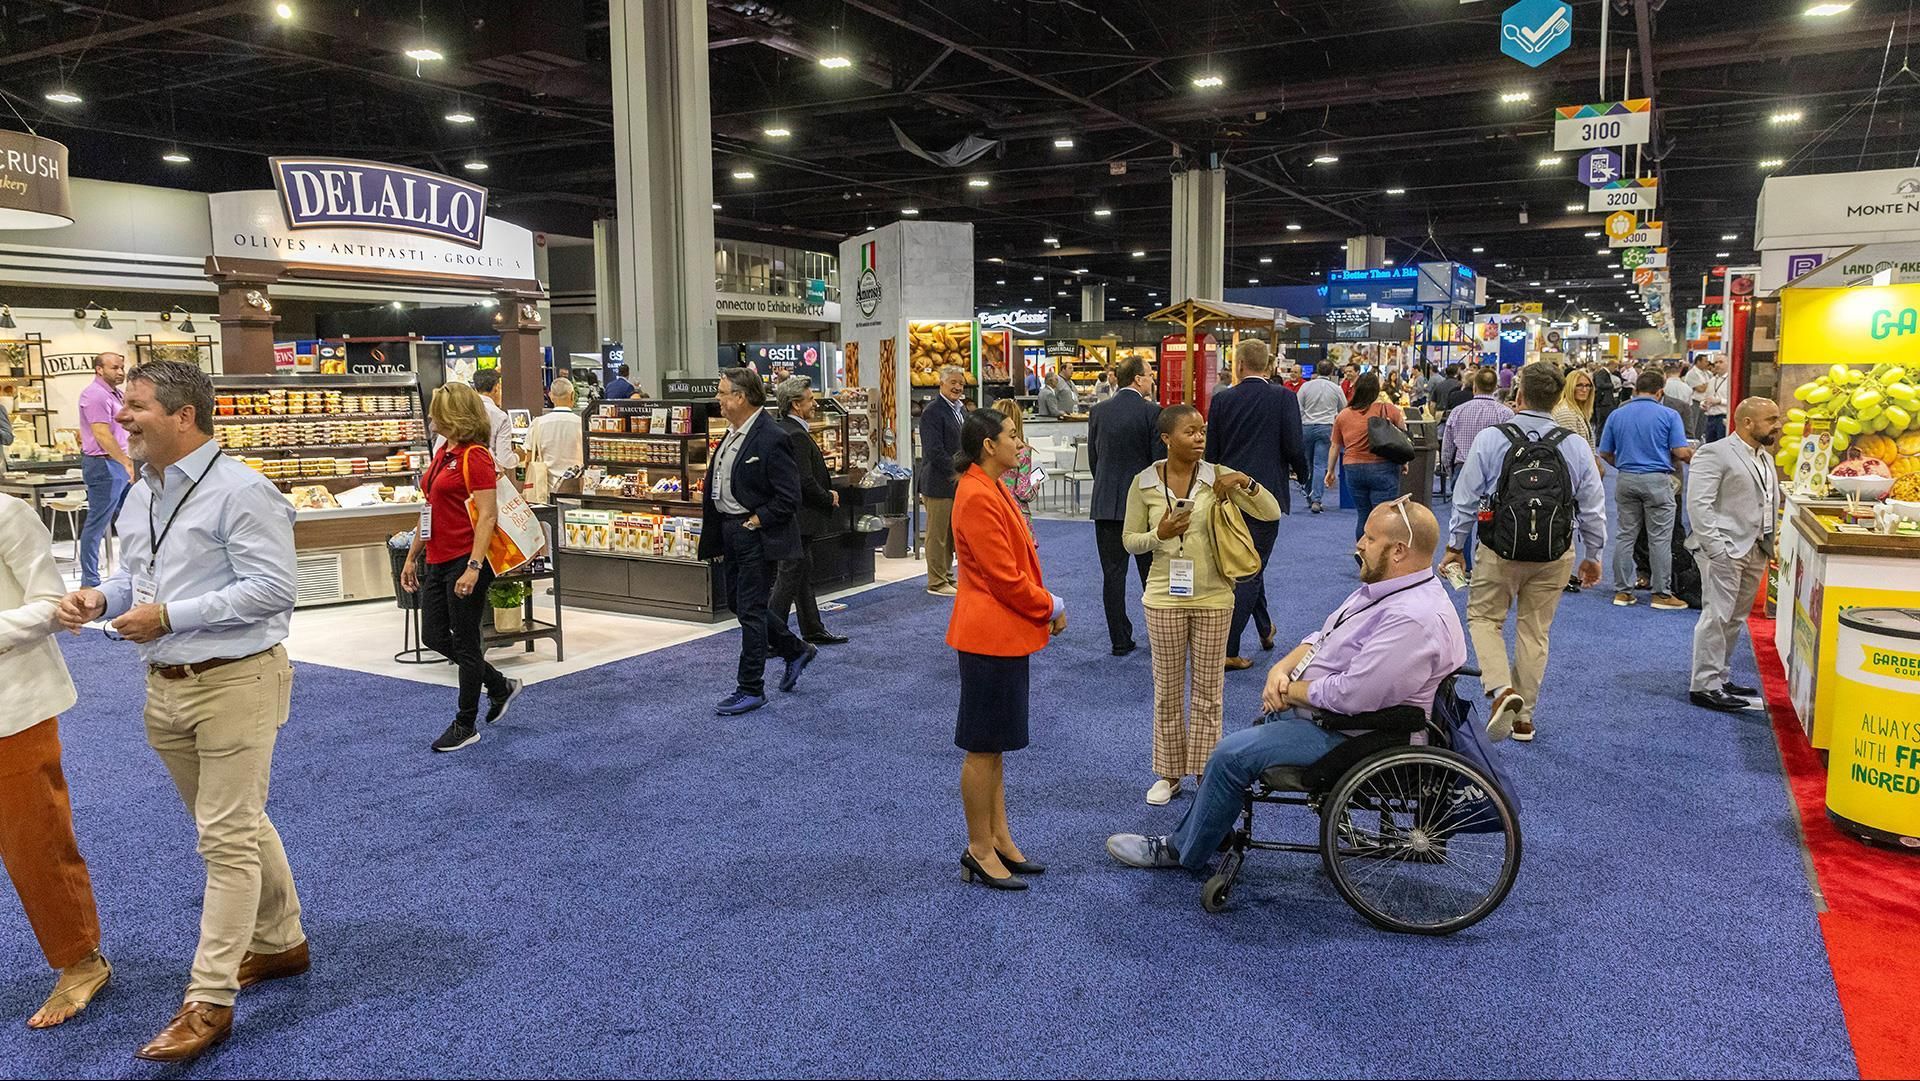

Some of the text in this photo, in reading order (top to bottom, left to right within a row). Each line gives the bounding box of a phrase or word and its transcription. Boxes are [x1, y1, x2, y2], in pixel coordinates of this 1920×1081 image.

[1582, 121, 1620, 141] 3100
[0, 174, 28, 195] kery
[290, 170, 476, 234] DELALLO
[1607, 192, 1638, 206] 3200
[1847, 201, 1920, 217] MONTE N
[234, 233, 306, 250] OLIVES
[330, 242, 425, 261] ANTIPASTI
[1343, 270, 1369, 280] Better
[1370, 269, 1391, 279] Than
[1392, 269, 1400, 278] A
[1402, 267, 1418, 277] Bla
[1843, 263, 1874, 275] LAND
[716, 300, 756, 311] onnector
[757, 302, 766, 311] to
[767, 300, 791, 313] Exhibit
[792, 304, 807, 315] Halls
[1871, 308, 1917, 340] GA
[768, 344, 798, 361] esti
[691, 385, 717, 393] OLIVES
[1873, 652, 1920, 669] GARDE
[1861, 713, 1920, 743] ALWAYS
[1854, 737, 1920, 770] WITH FR
[1851, 763, 1920, 794] INGRED
